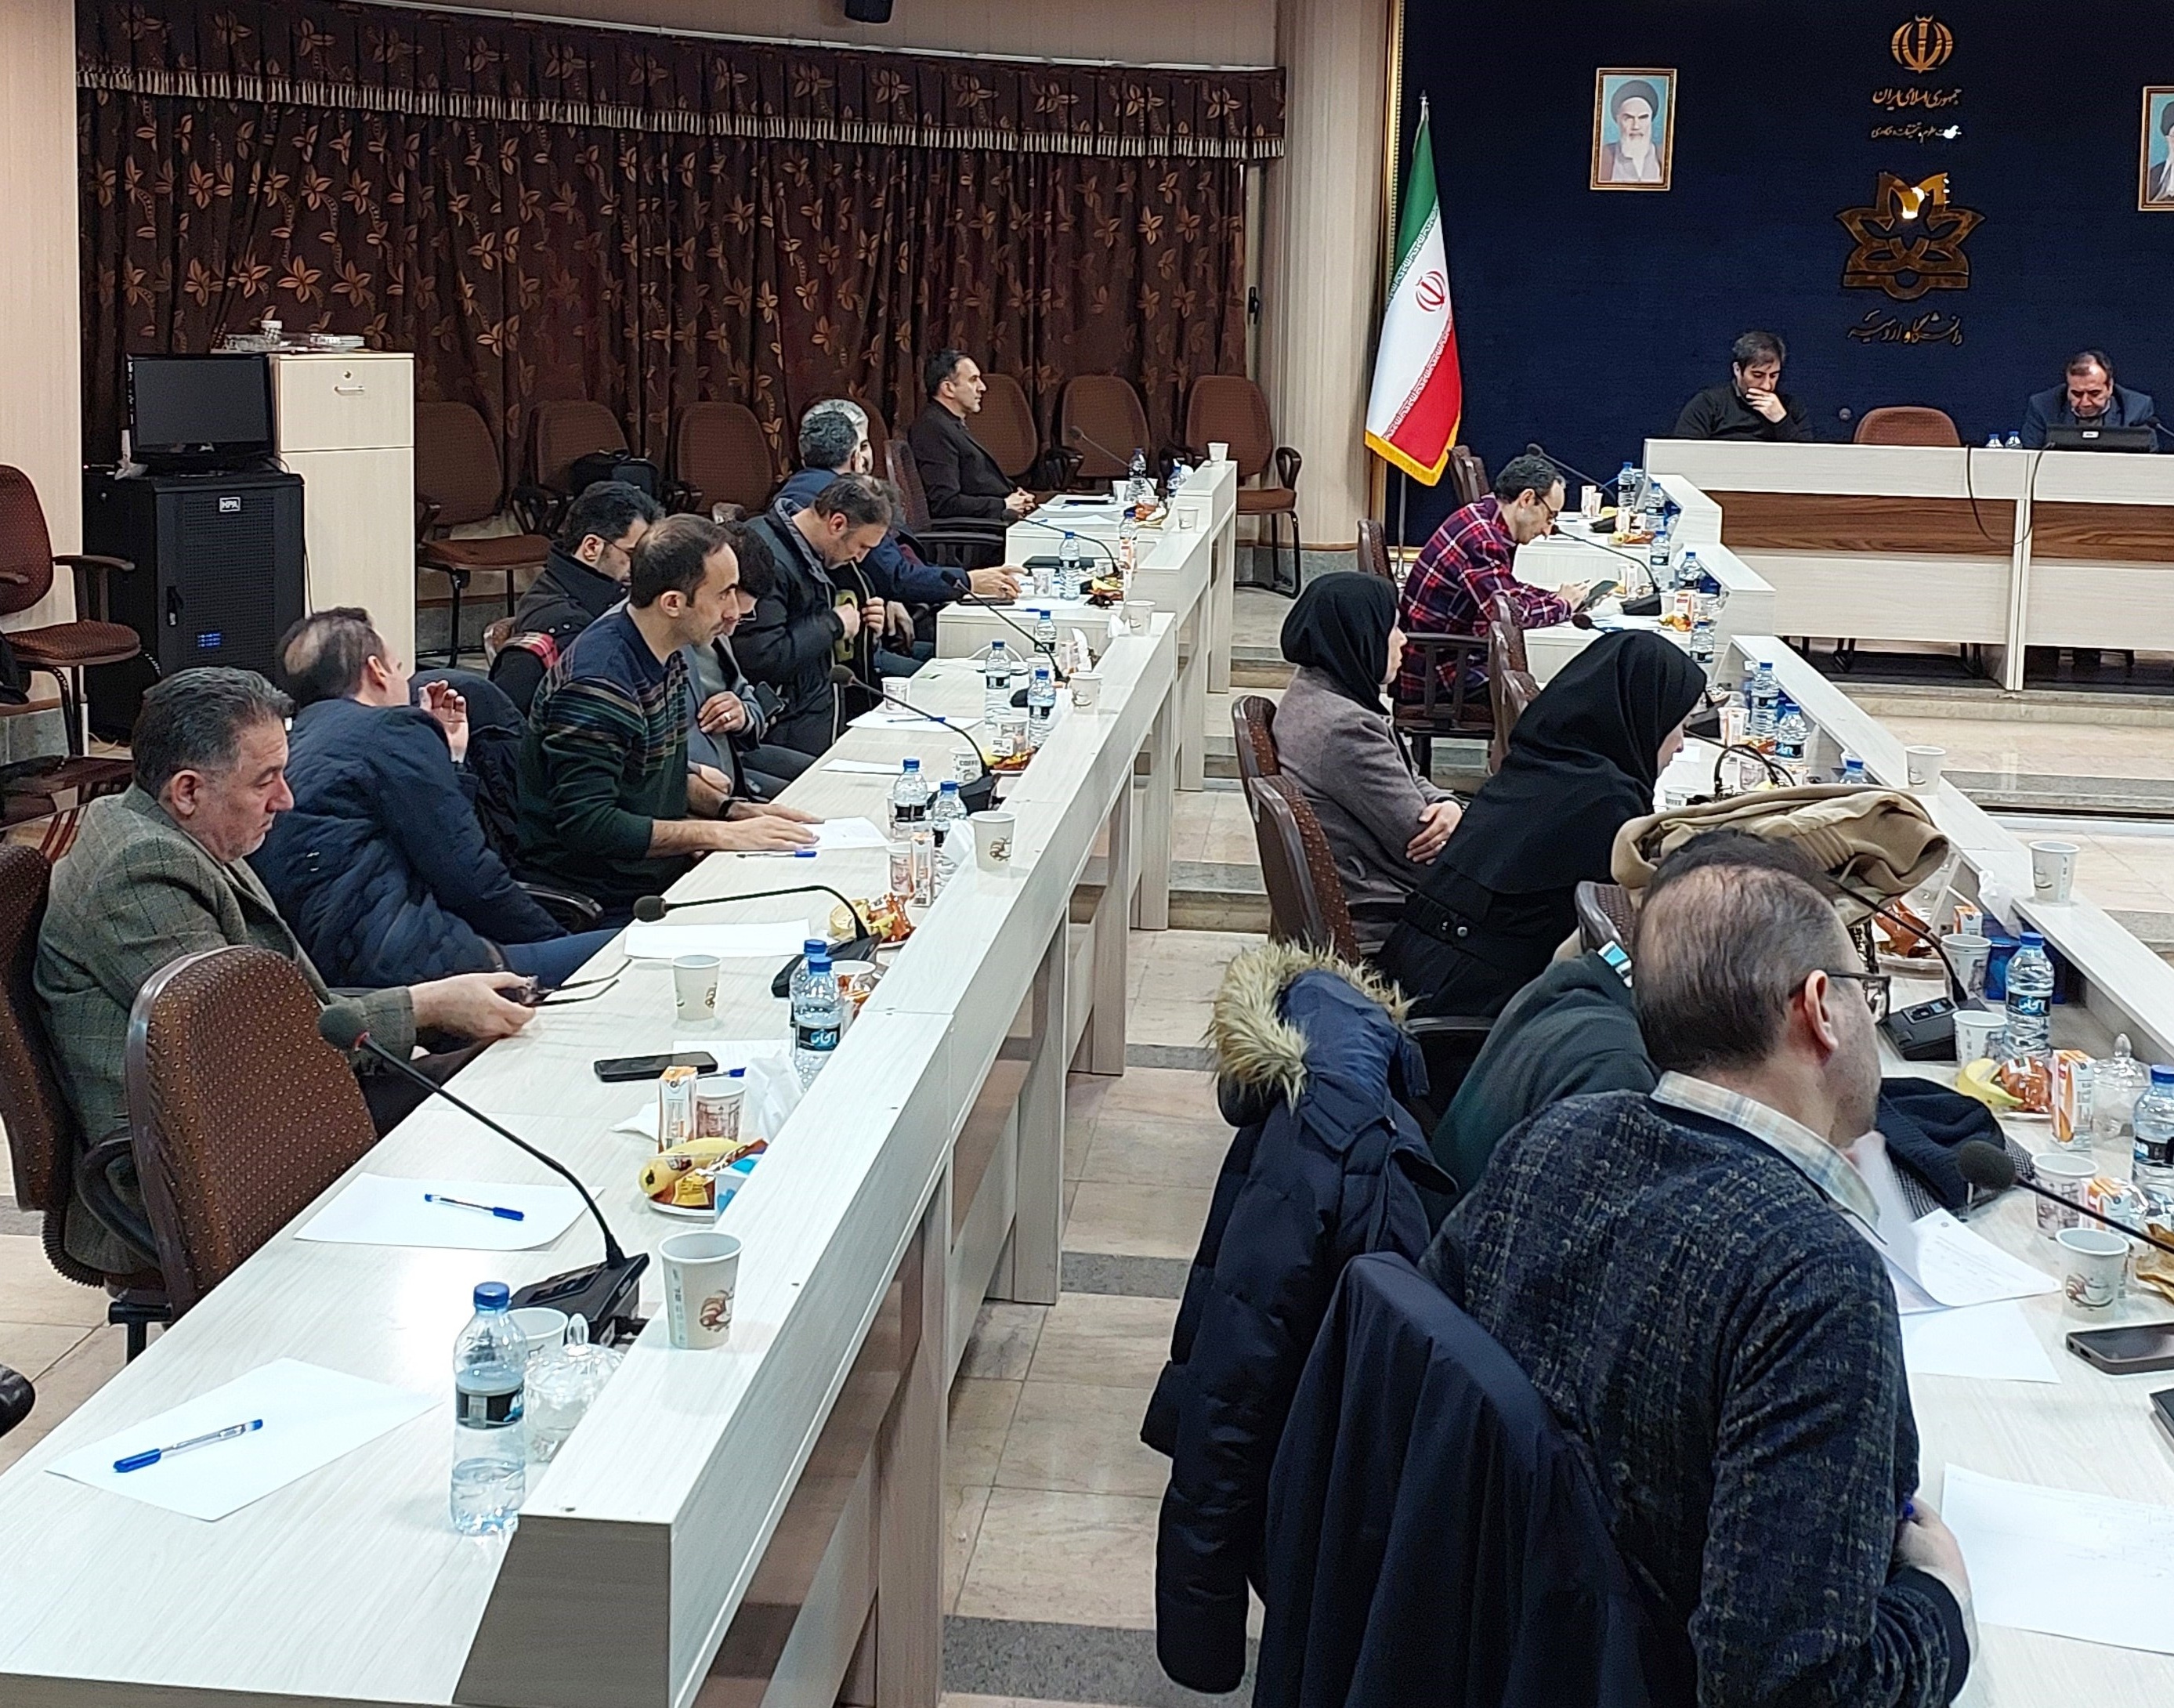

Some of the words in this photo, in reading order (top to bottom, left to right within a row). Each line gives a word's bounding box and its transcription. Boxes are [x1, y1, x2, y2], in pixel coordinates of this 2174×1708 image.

[1872, 89, 1901, 110] ایران
[1897, 88, 1928, 107] اسلامی
[1926, 89, 1962, 108] جمهوری
[1847, 309, 1903, 342] ارومیه
[1904, 313, 1962, 345] دانشگاه
